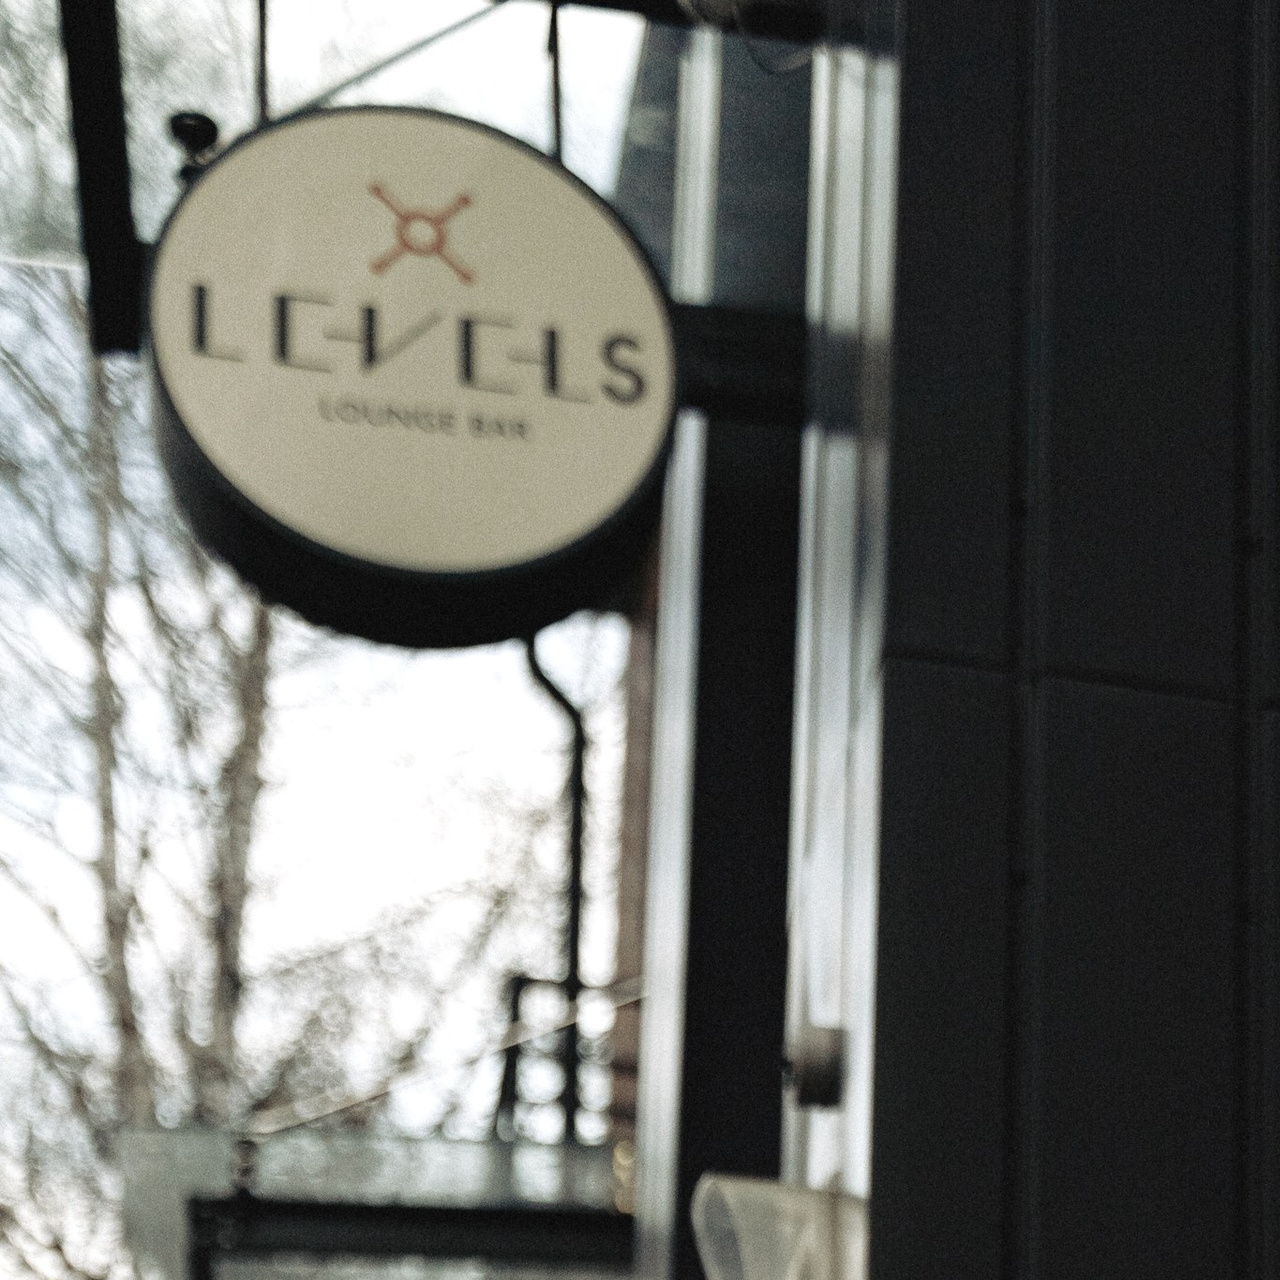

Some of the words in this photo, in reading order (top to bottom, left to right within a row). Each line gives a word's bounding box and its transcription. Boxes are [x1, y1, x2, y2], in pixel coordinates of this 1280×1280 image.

[190, 284, 646, 404] LEVELS
[318, 397, 456, 436] LOUNGE
[466, 411, 531, 441] BAR
